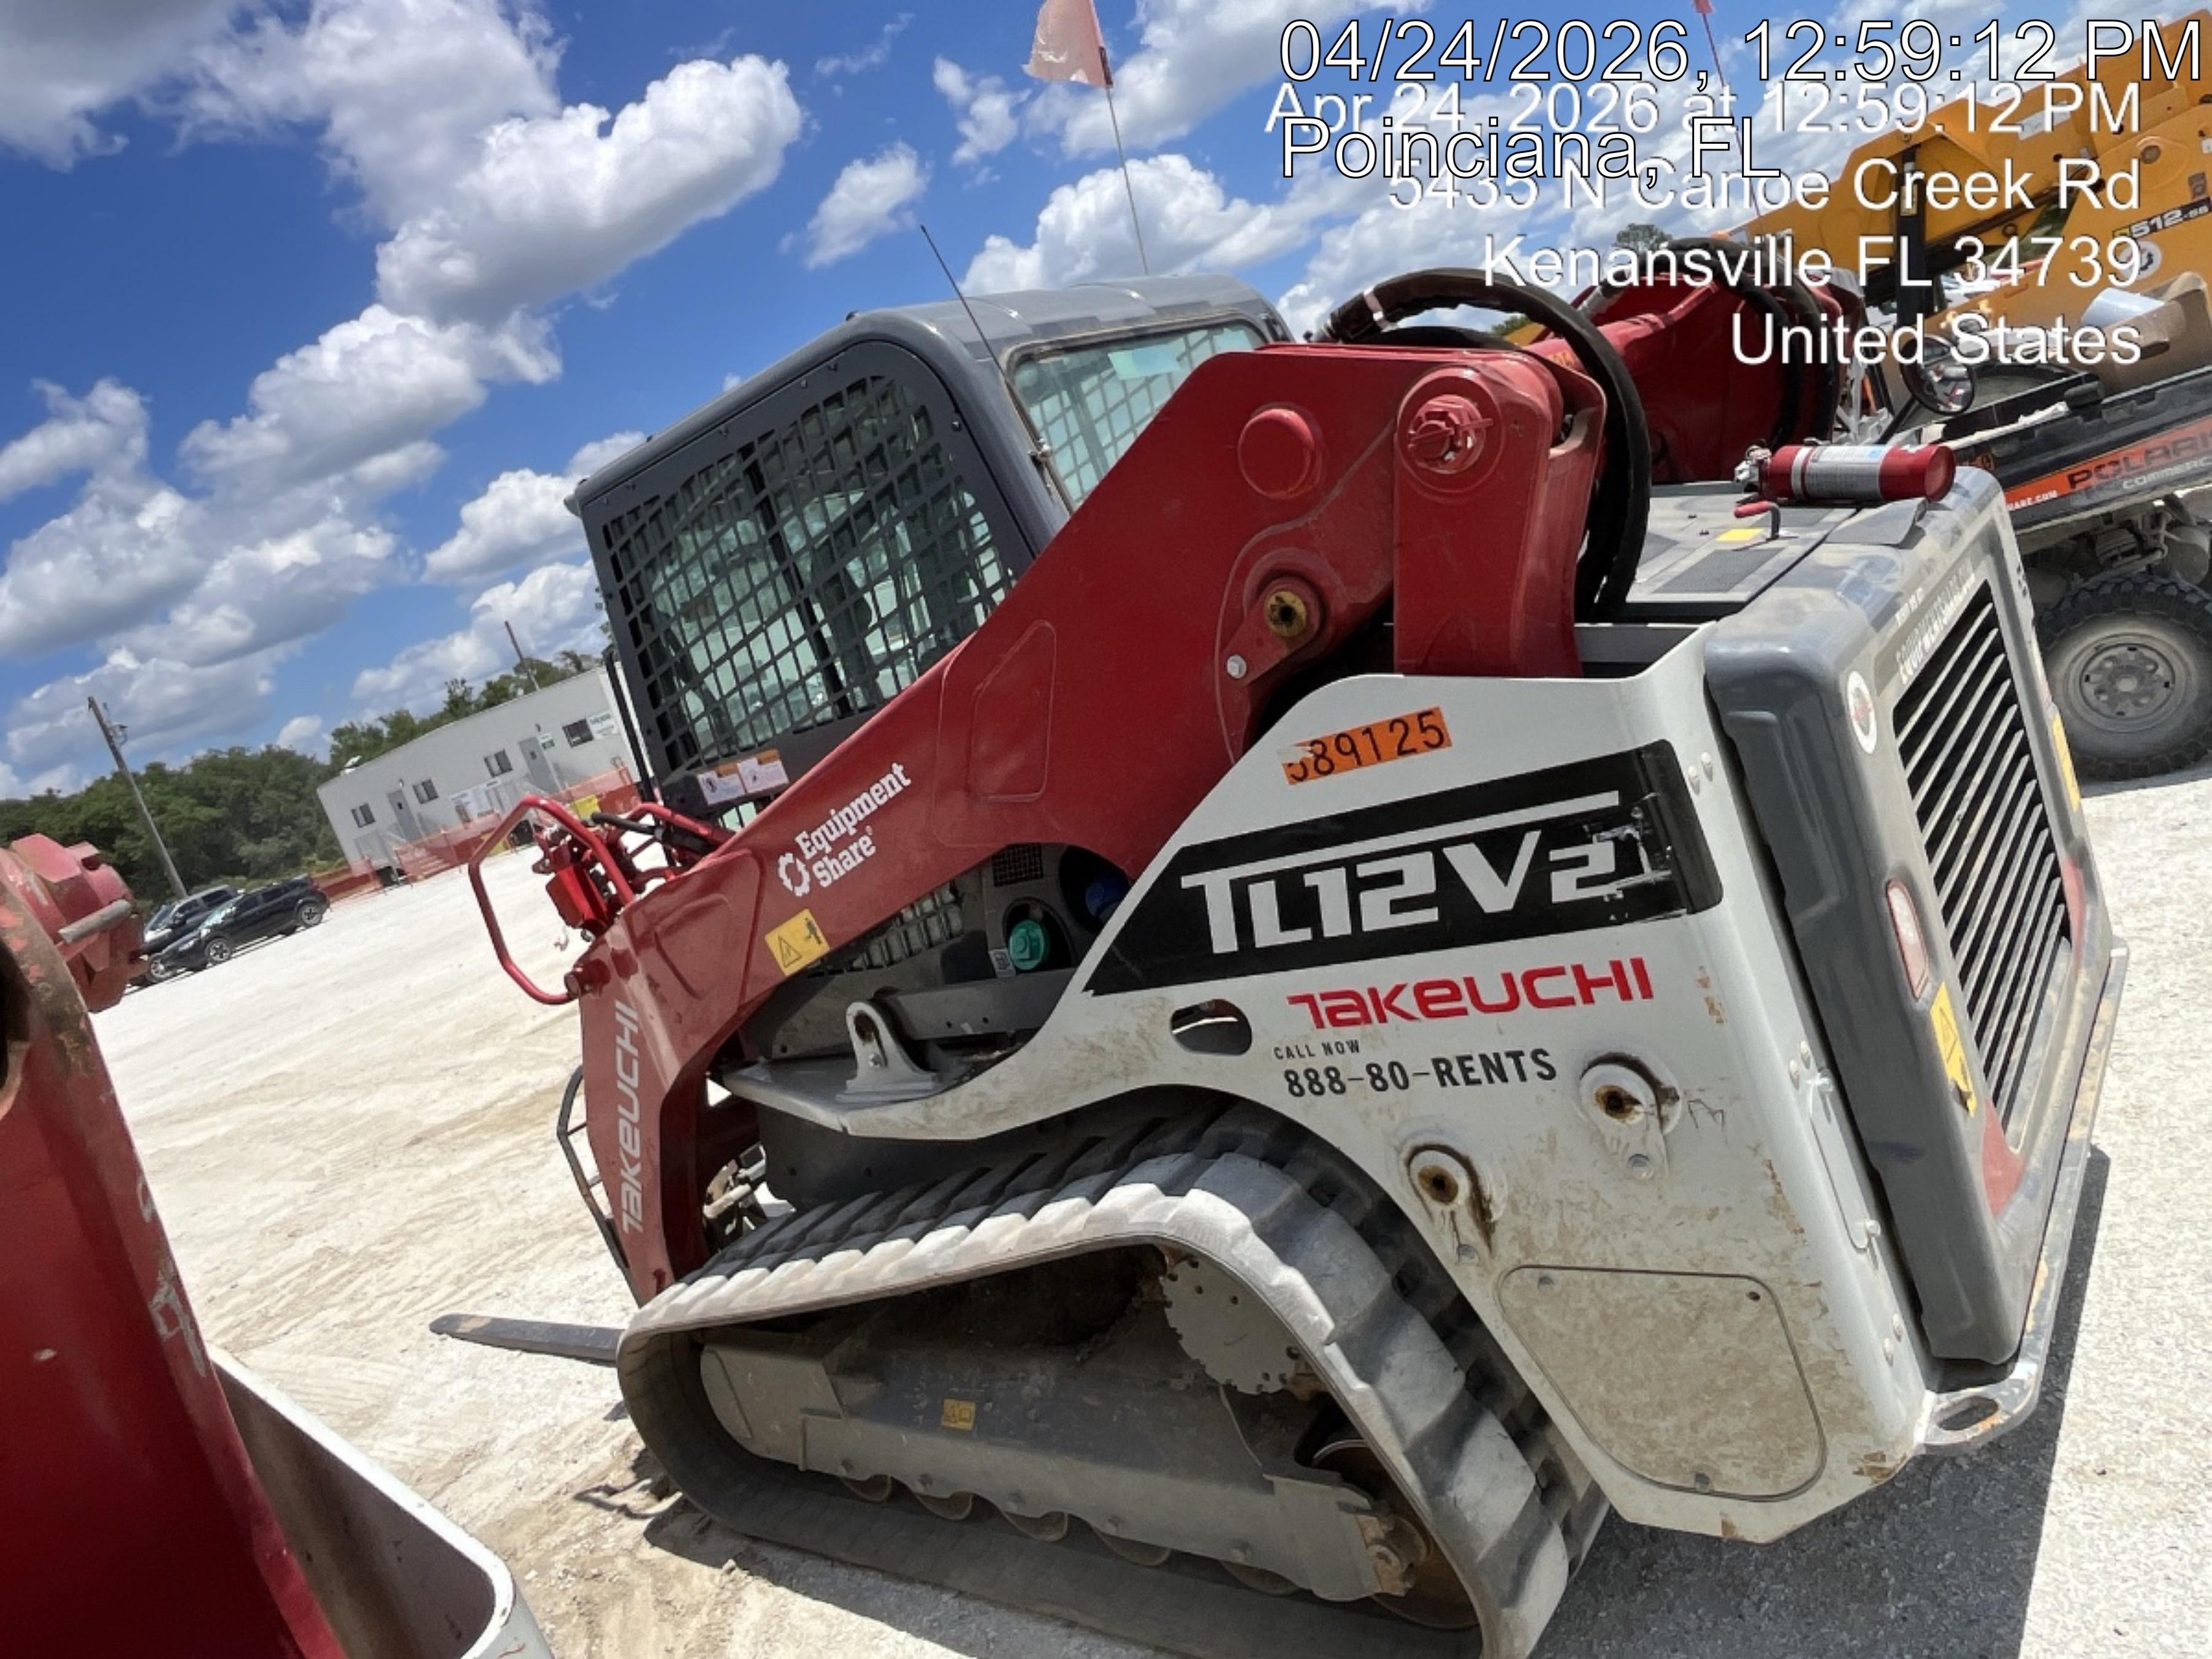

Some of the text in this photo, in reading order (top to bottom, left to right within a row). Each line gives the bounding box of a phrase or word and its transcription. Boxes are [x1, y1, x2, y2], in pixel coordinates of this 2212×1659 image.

[2068, 431, 2212, 489] POLARI
[794, 762, 912, 860] Equipment
[1181, 791, 1620, 954] TL12V2
[1273, 1039, 1360, 1060] CALL NOW
[1283, 1048, 1558, 1099] 888-80-RENTS
